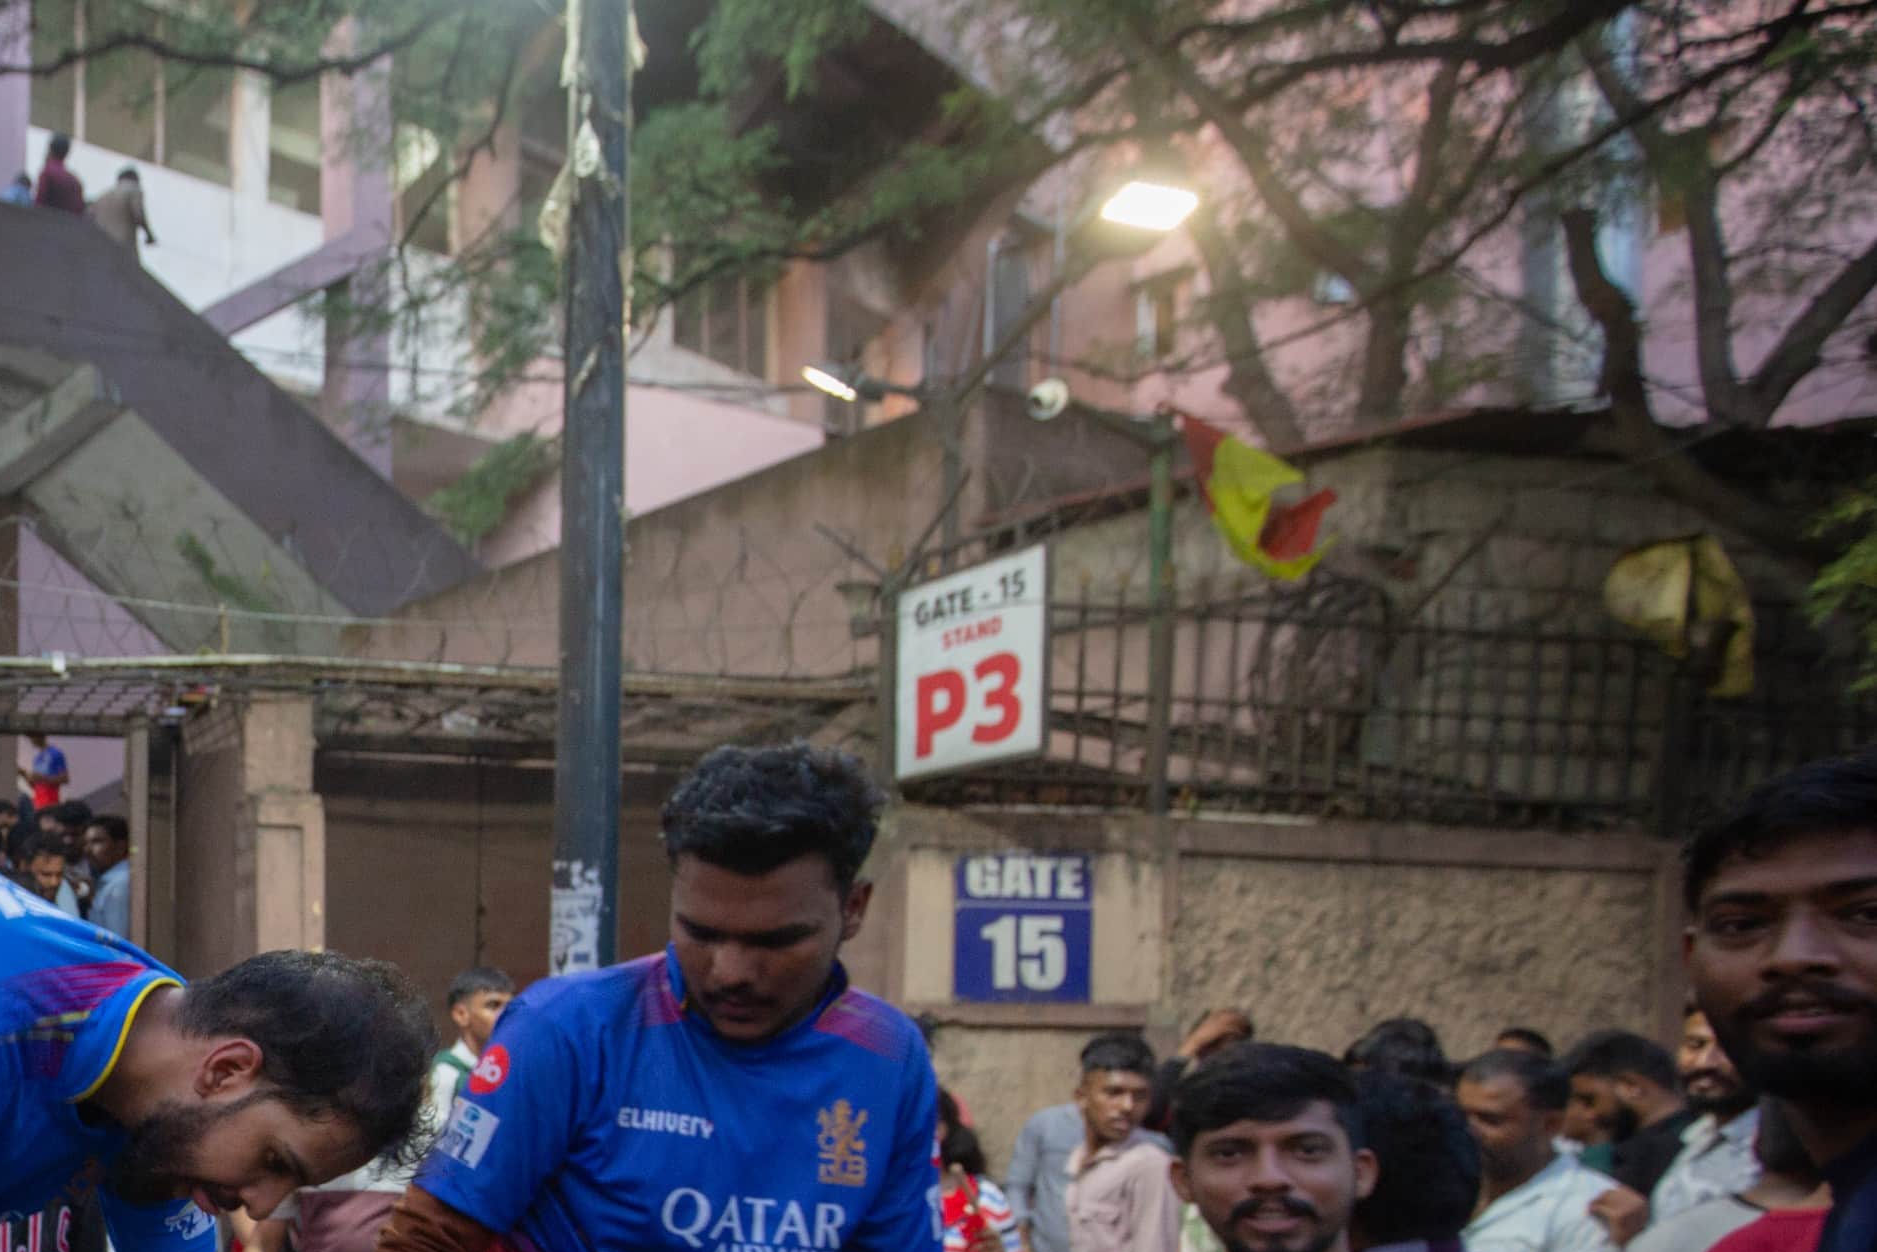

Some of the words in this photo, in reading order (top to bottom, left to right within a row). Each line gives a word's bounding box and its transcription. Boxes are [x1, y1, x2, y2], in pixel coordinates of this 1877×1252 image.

[914, 585, 973, 628] GATE
[997, 569, 1026, 600] 15
[942, 614, 1002, 652] STAND
[915, 651, 1022, 760] P3
[965, 857, 1085, 900] GATE
[979, 913, 1068, 992] 15
[661, 1186, 847, 1249] QATAR
